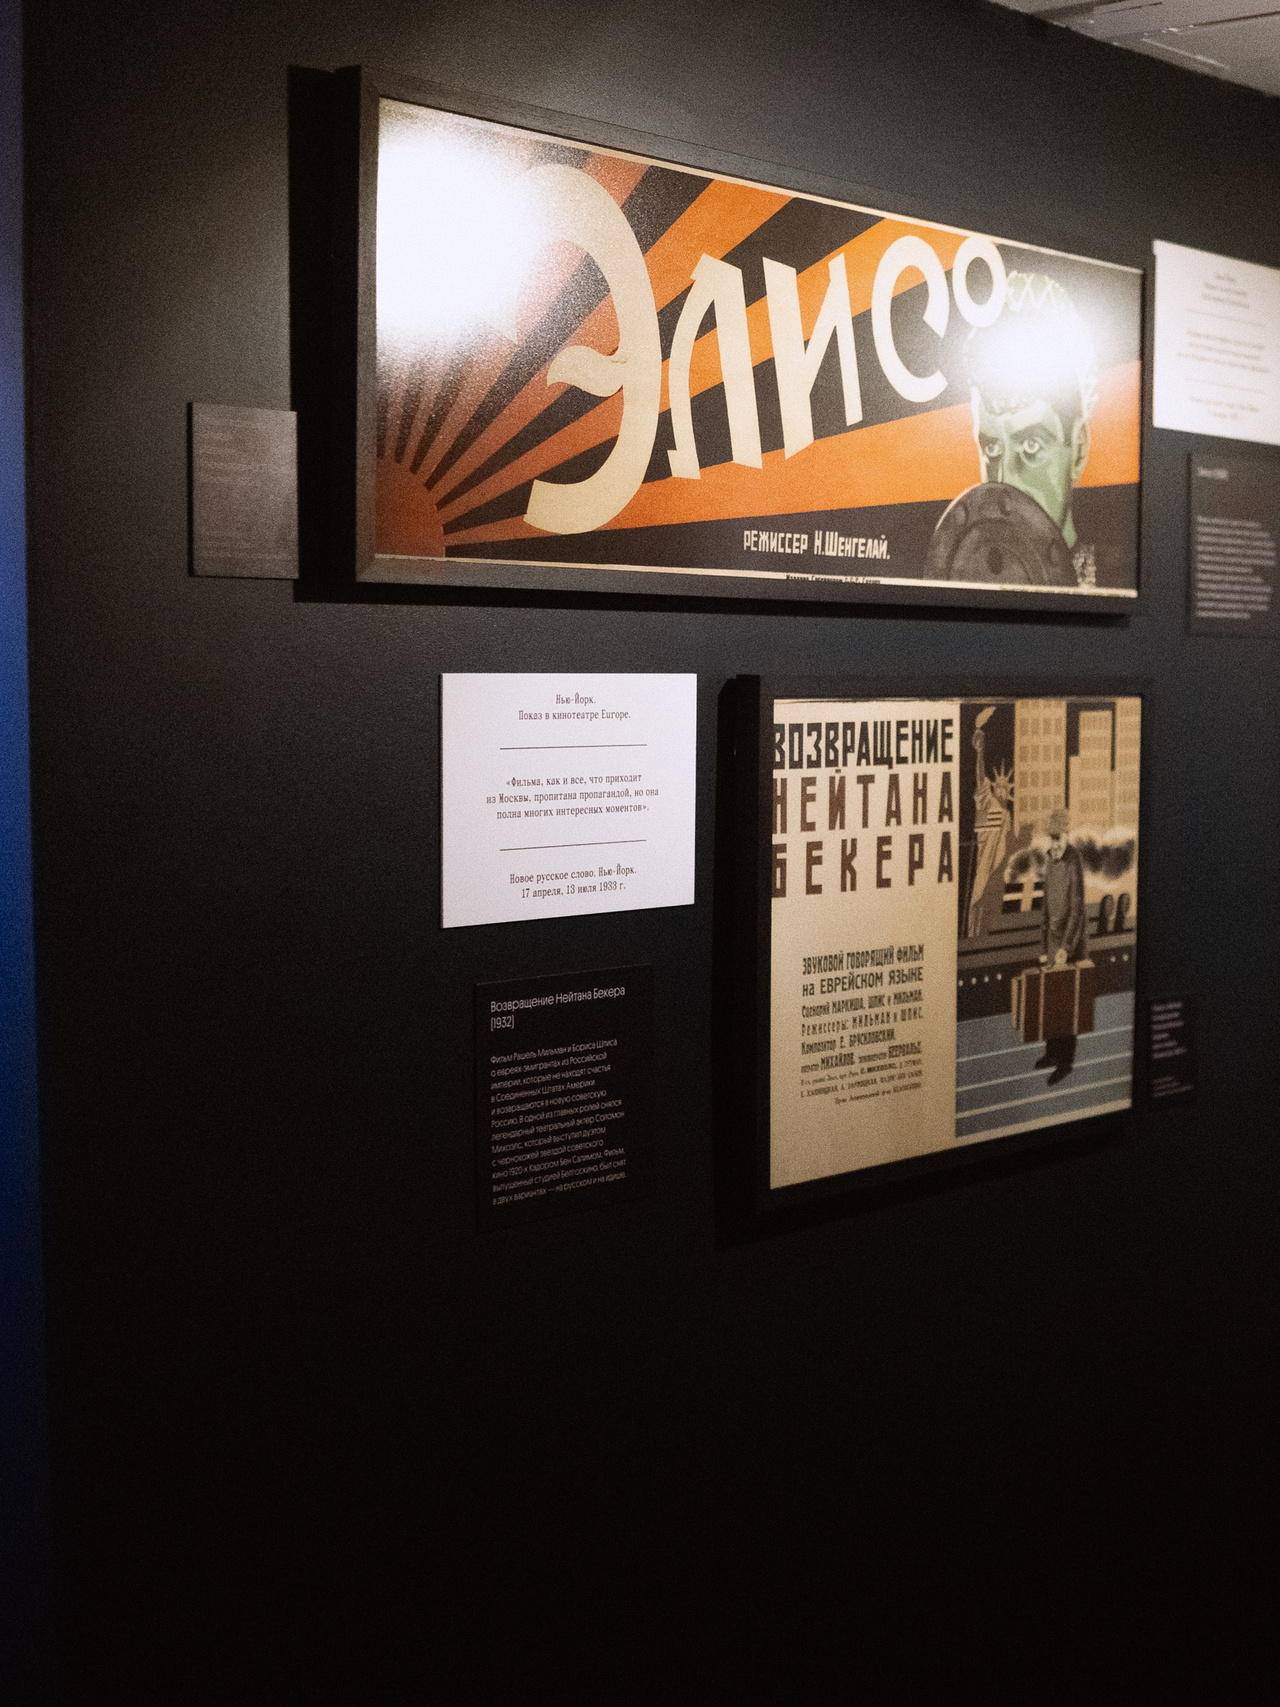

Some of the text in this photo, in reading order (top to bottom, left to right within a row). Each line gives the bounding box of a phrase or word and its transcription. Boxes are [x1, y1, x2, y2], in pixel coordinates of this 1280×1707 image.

[523, 164, 1006, 534] ЭЛИСО
[743, 530, 808, 554] РЕЖИССЕР
[556, 692, 596, 706] Нью-Йорк.
[518, 709, 542, 720] Показ
[552, 711, 598, 721] кинотеатре
[601, 709, 630, 720] Europe.
[773, 719, 953, 770] ВОЗВРАЩЕНИЕ
[506, 777, 543, 786] «Фильма,
[546, 777, 560, 785] как
[570, 776, 586, 784] все,
[605, 774, 641, 785] приходит
[486, 796, 496, 804] из
[498, 793, 531, 803] Москвы,
[534, 792, 576, 803] пропитана
[579, 788, 631, 801] пропагандой,
[645, 788, 658, 796] она
[773, 769, 953, 834] НЕЙТАНА
[496, 810, 521, 819] полна
[524, 809, 552, 817] многих
[556, 806, 602, 816] интересных
[509, 863, 636, 884] Новое русское слово. Нью-Йорк.
[772, 831, 953, 898] БЕКЕРА
[521, 887, 529, 898] 17
[532, 888, 563, 899] апреля,
[566, 884, 574, 894] 13
[577, 885, 596, 893] июля
[599, 880, 617, 891] 1933
[490, 986, 625, 1012] Возвращение Нейтана Бекера
[802, 983, 814, 996] на
